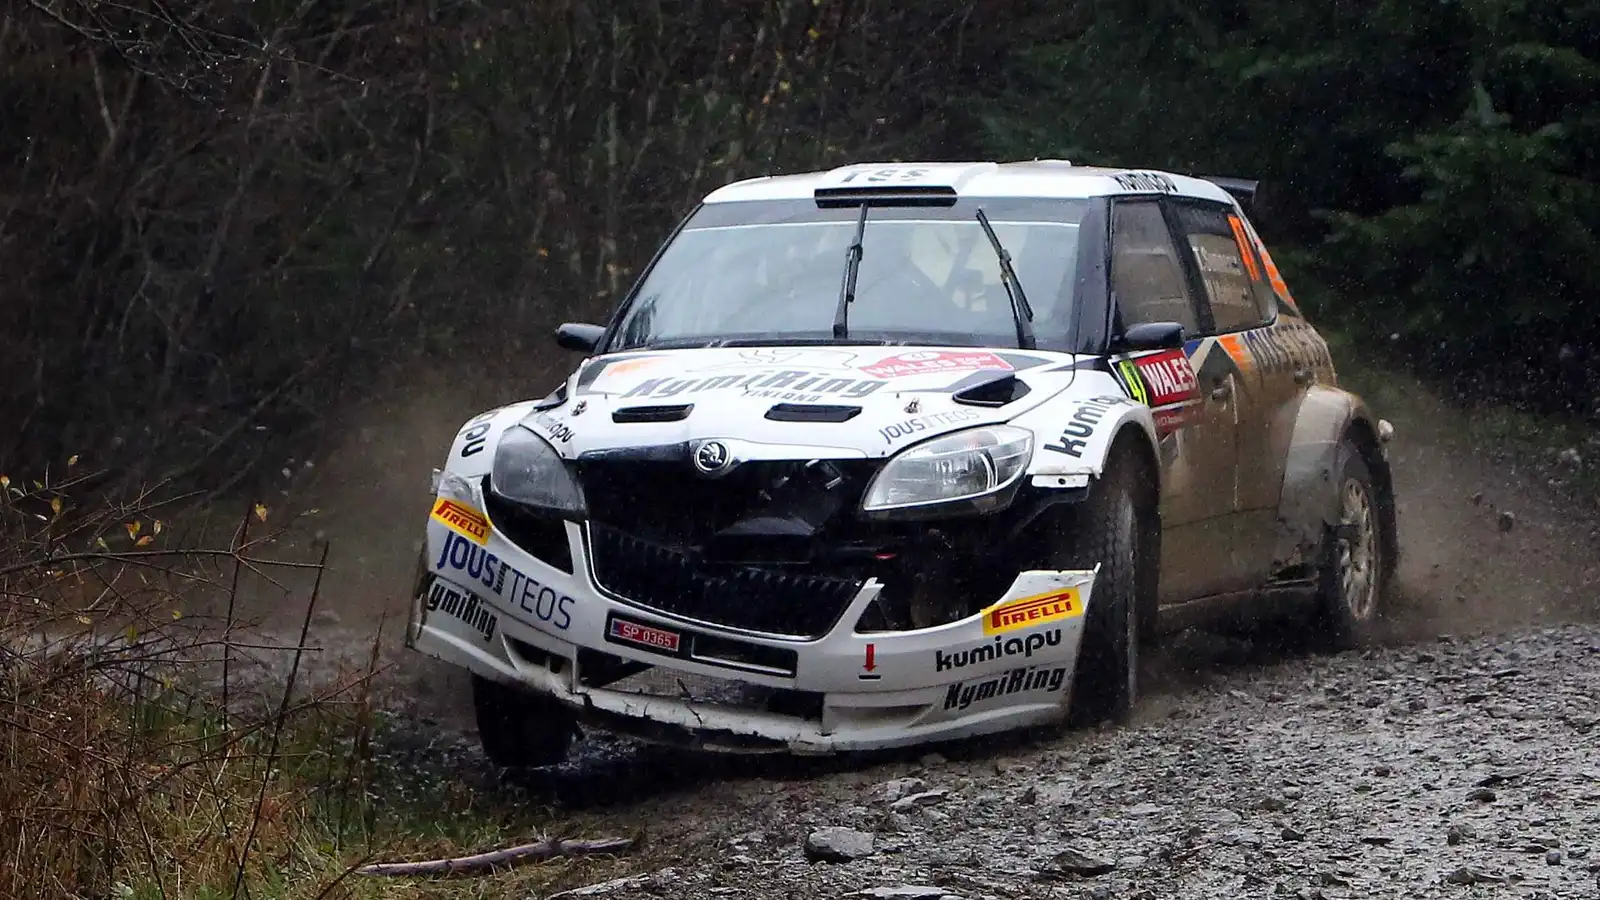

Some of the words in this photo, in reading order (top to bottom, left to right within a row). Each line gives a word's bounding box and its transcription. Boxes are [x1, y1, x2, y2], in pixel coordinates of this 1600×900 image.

[619, 370, 888, 398] KymiRing
[1140, 357, 1196, 397] WALES
[435, 500, 489, 539] PIRELLI
[426, 583, 498, 641] ymiRing
[992, 592, 1072, 628] PIRELLI
[622, 624, 639, 639] SP
[642, 629, 672, 648] 0365
[935, 628, 1062, 672] kumiapu
[944, 667, 1066, 711] KymiRing
